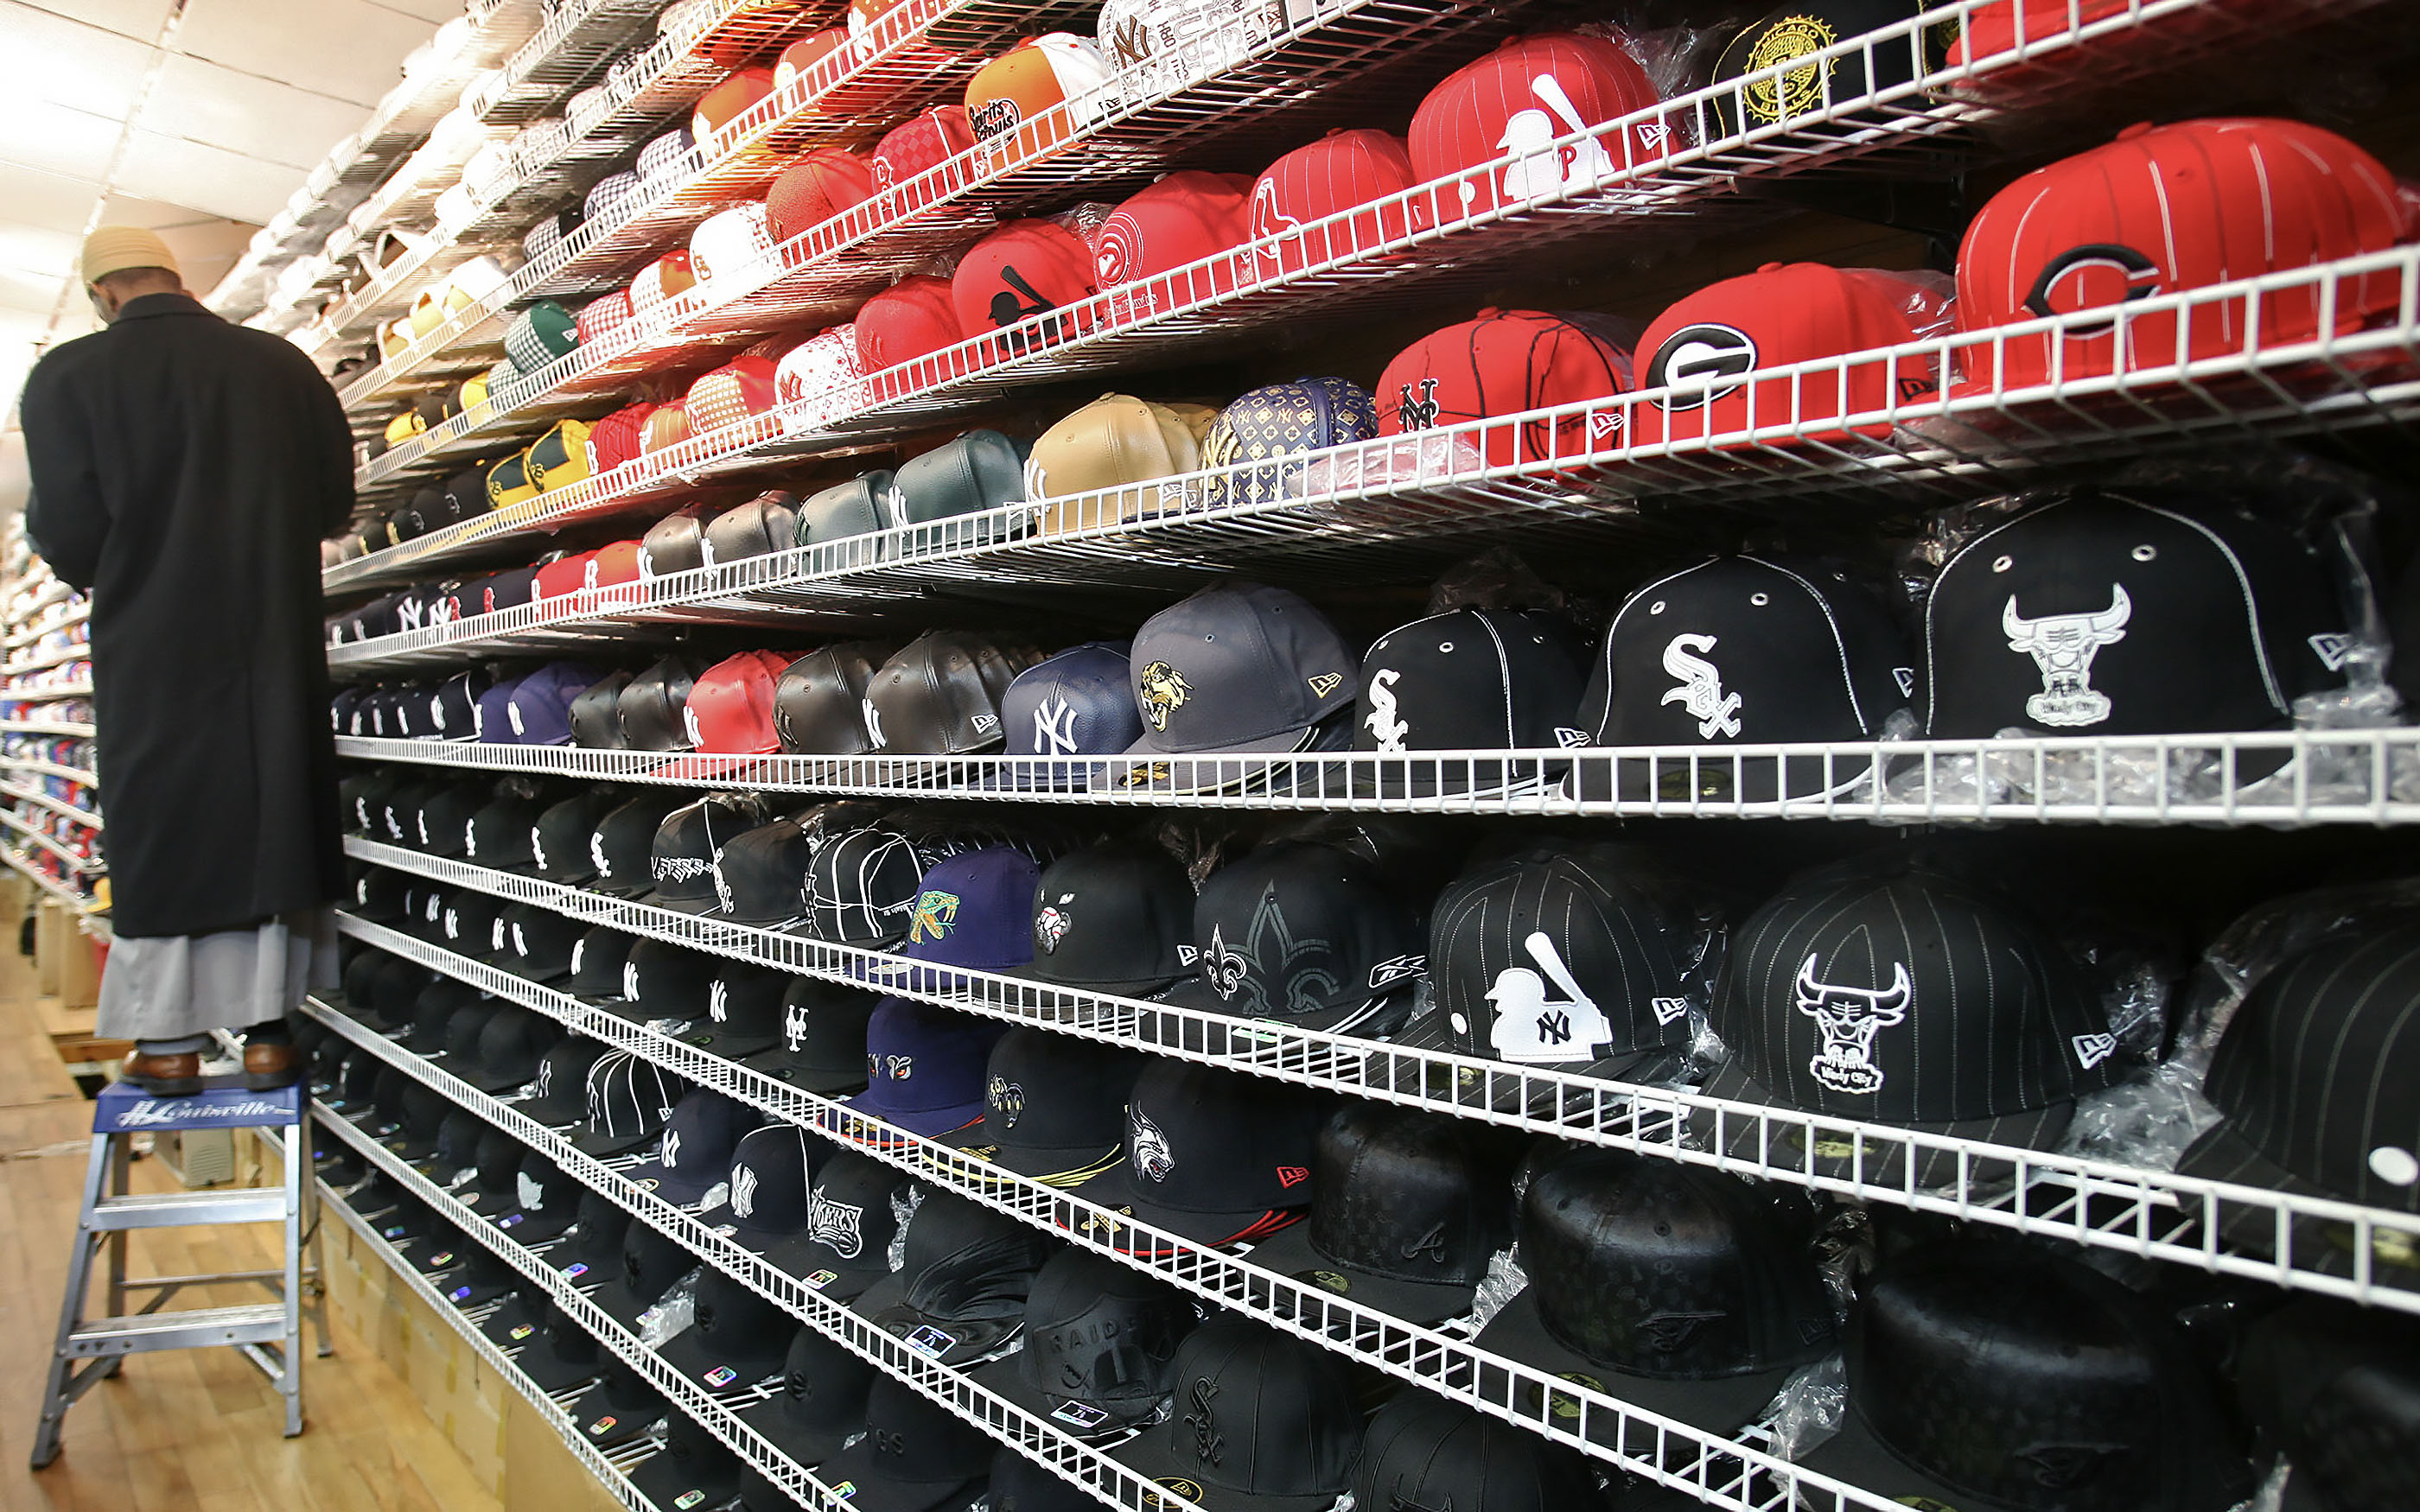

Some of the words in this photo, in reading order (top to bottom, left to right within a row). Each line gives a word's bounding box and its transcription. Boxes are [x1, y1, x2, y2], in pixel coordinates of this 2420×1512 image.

[1557, 145, 1577, 182] P
[2020, 245, 2162, 340] C
[1645, 322, 1758, 412] G
[398, 596, 422, 632] NY
[1661, 633, 1742, 740] Sox
[1034, 696, 1079, 757] NY
[1536, 1009, 1572, 1045] NY
